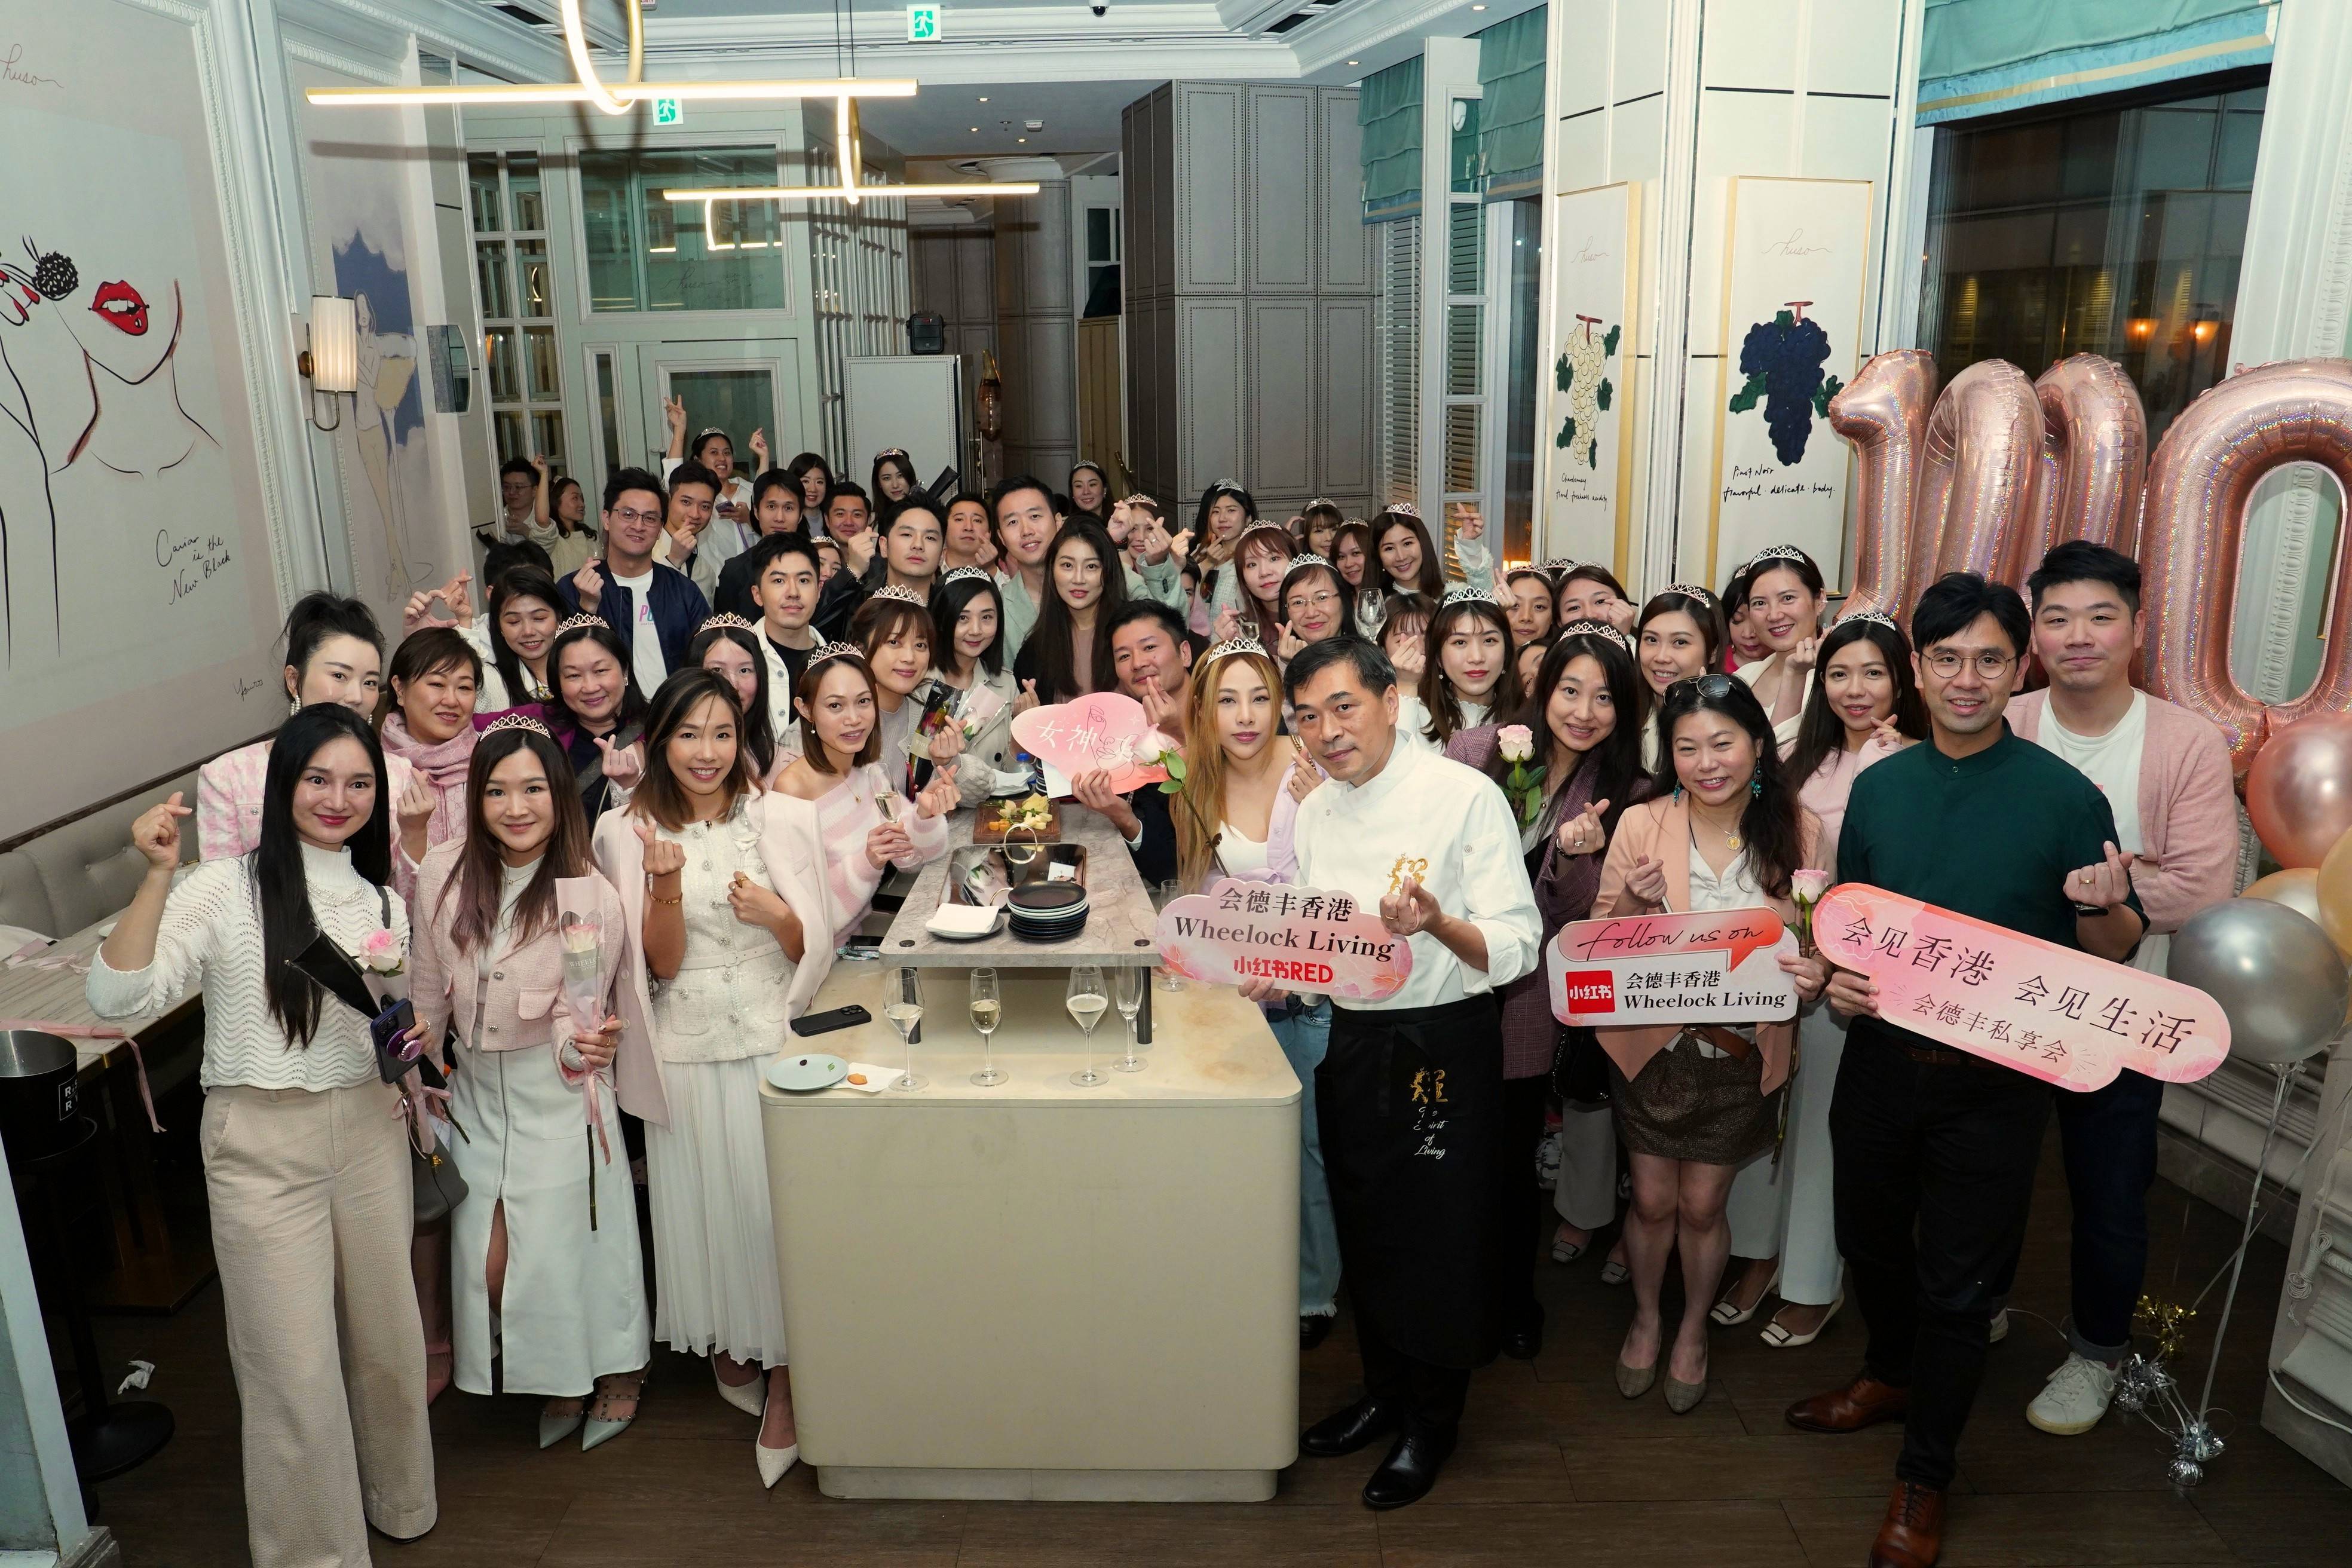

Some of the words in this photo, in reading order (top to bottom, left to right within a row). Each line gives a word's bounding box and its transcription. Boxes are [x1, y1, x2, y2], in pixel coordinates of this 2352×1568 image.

[1760, 228, 1833, 256] huso
[1732, 466, 1752, 480] Pinot
[1754, 464, 1774, 476] Noir
[1771, 483, 1805, 495] delicate
[156, 529, 200, 566] Caviar
[207, 534, 224, 553] the
[169, 568, 199, 605] New
[203, 549, 231, 579] Black
[1219, 887, 1353, 922] 会德丰香港
[1175, 916, 1300, 948] Wheelock
[1307, 930, 1395, 962] Living
[1690, 930, 1721, 943] us
[1728, 927, 1764, 940] on
[1626, 970, 1721, 990] 会德丰香港
[1841, 917, 1995, 987] 会见香港
[2014, 975, 2196, 1054] 会见生活
[1569, 985, 1613, 1000] 小红书
[1624, 993, 1717, 1009] Wheelock
[1722, 991, 1787, 1009] Living
[1912, 993, 2068, 1064] 会德丰私享会
[1413, 1119, 1449, 1131] Sirit
[1425, 1133, 1435, 1146] of
[1414, 1144, 1446, 1160] Living
